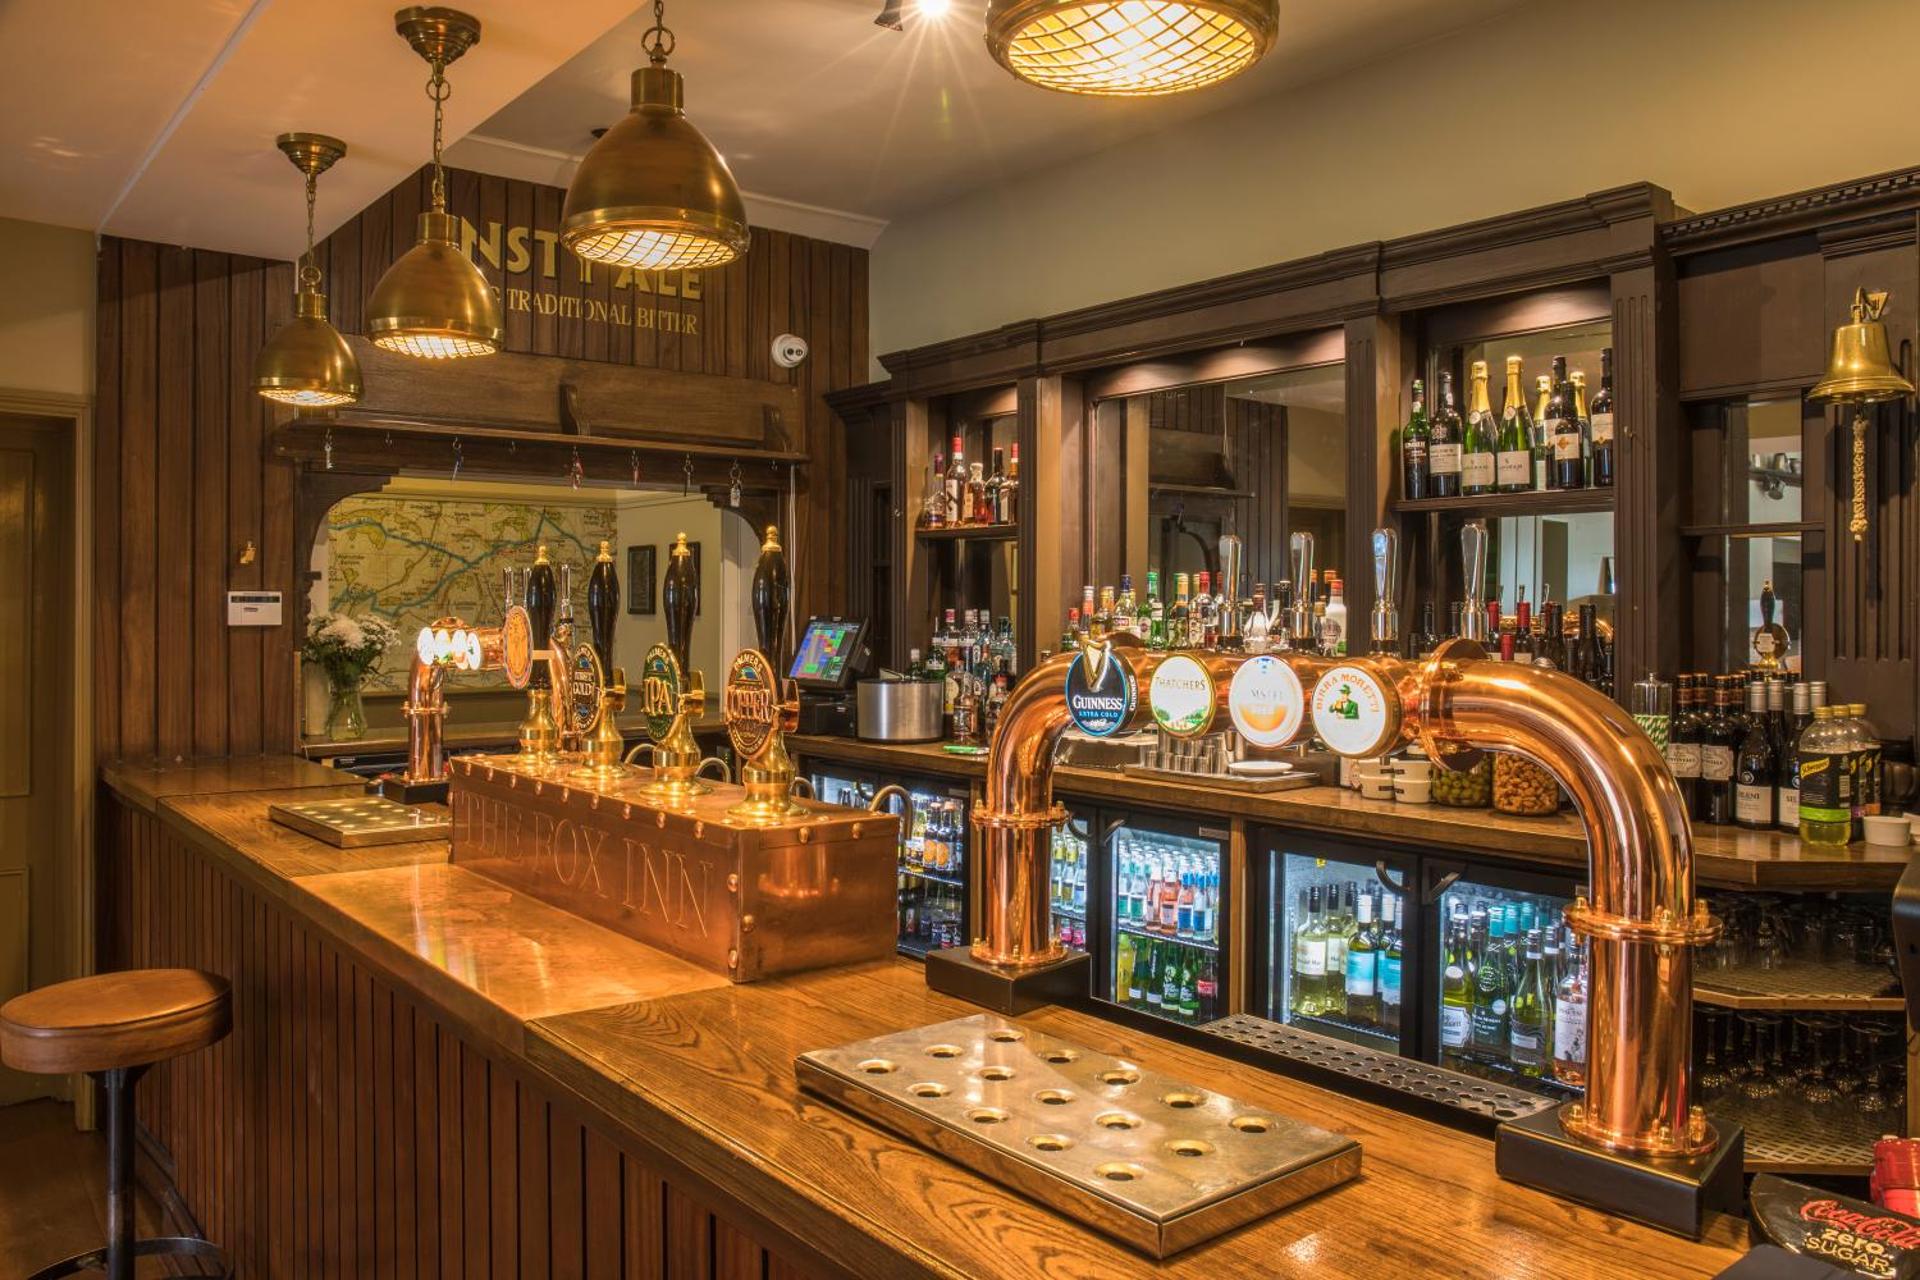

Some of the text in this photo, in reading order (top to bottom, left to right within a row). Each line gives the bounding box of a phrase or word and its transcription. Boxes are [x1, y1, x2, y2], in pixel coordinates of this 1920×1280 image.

[507, 288, 632, 326] TRADITIONAL
[636, 306, 698, 335] BITTER
[641, 677, 673, 716] IPA
[1072, 694, 1123, 711] GUINNESS
[1078, 710, 1119, 719] EXTRA COLD
[622, 838, 714, 939] INN
[1806, 1237, 1891, 1274] SUGAR
[1821, 1228, 1885, 1256] zero
